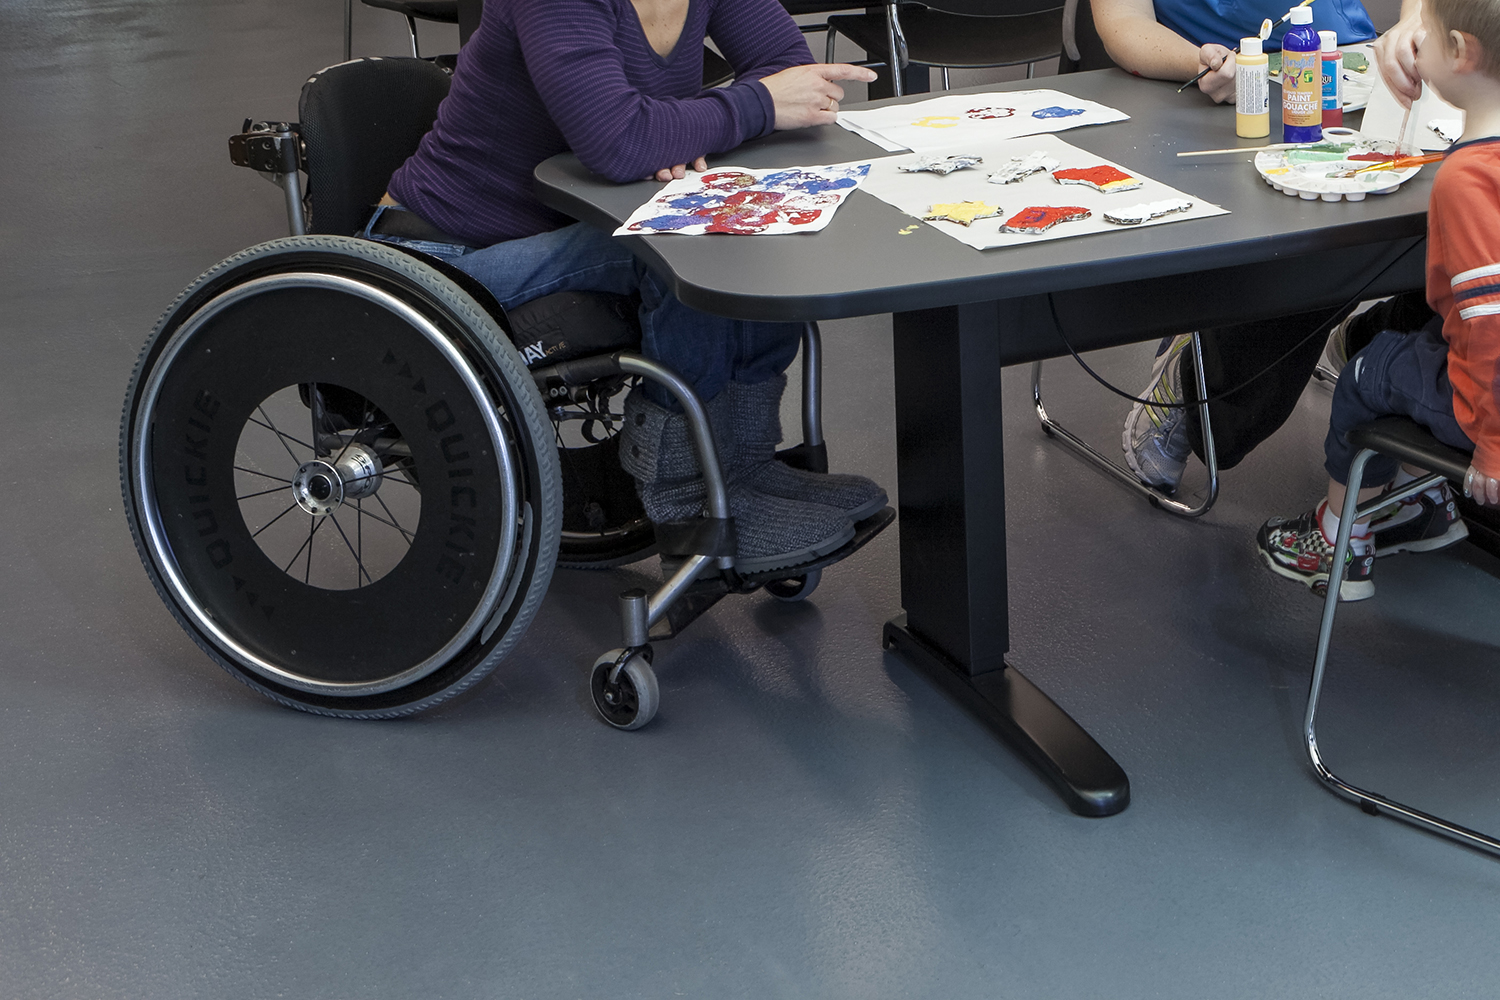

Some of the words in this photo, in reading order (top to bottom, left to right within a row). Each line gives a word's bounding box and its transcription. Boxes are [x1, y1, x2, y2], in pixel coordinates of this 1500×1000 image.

[1283, 102, 1318, 111] GOUACHE
[1288, 94, 1311, 102] PAINT
[185, 390, 232, 571] QUICKIE
[426, 402, 477, 584] QUICKIE
